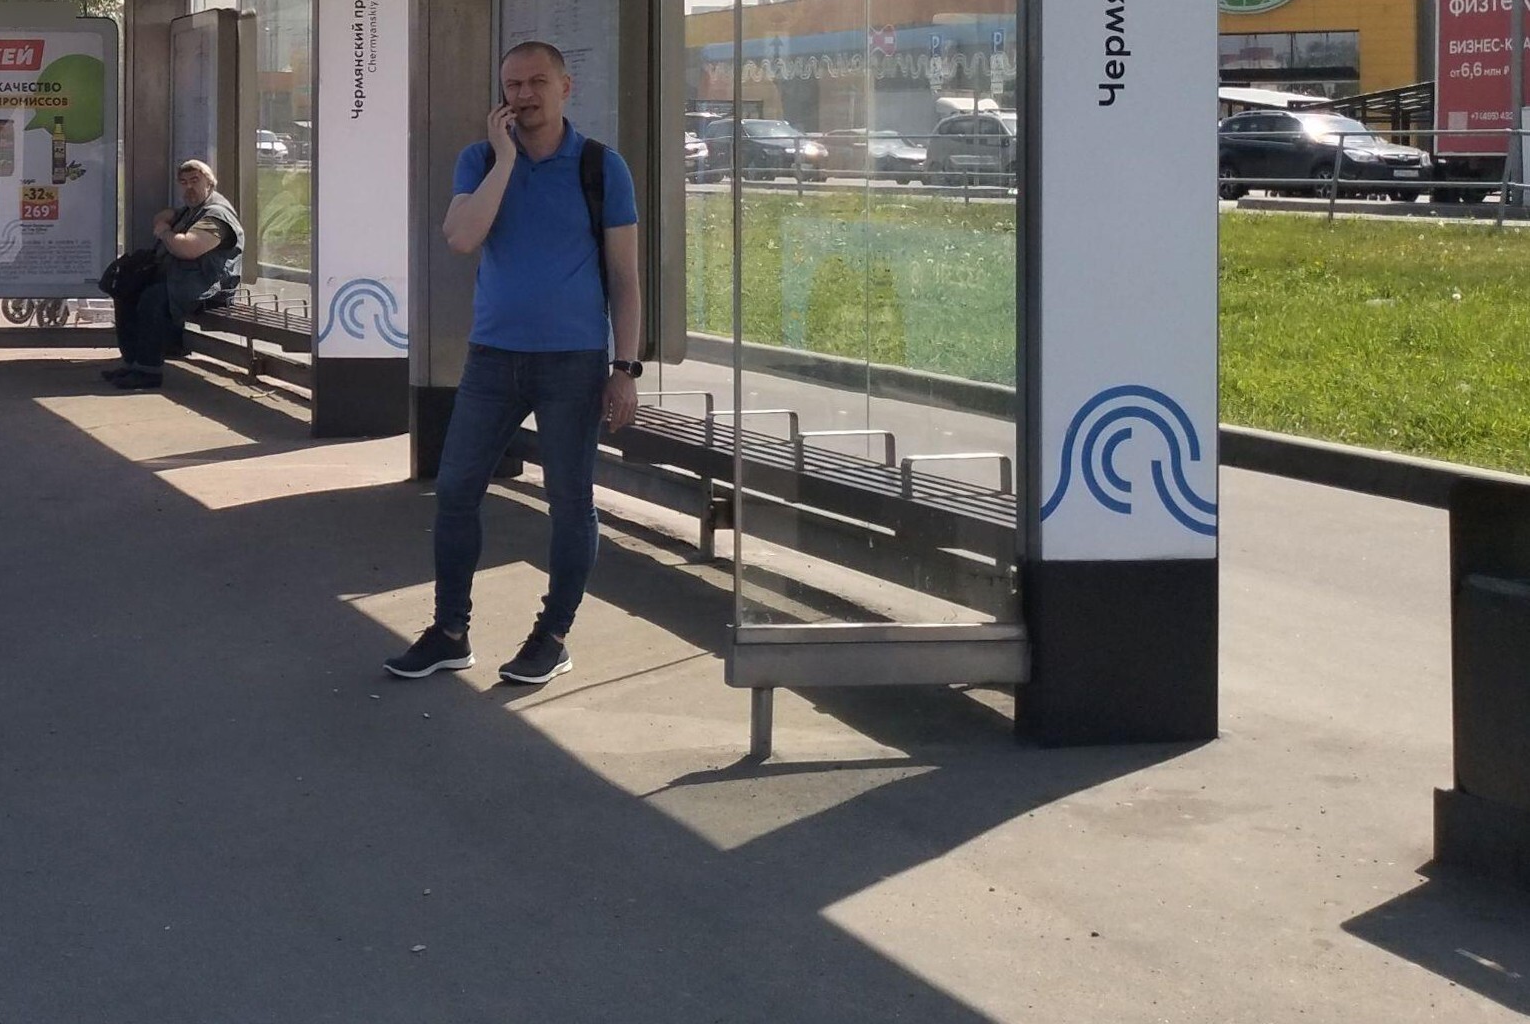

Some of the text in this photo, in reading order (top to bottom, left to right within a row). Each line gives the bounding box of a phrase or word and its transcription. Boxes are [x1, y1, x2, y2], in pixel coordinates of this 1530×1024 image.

[368, 0, 379, 73] Chermyanskiy
[1449, 37, 1530, 54] БИЗНЕС-КА
[351, 23, 366, 120] Чермянский
[1449, 69, 1460, 78] от
[1461, 61, 1482, 79] 6,6
[1483, 67, 1501, 76] млн
[24, 188, 54, 200] -32%
